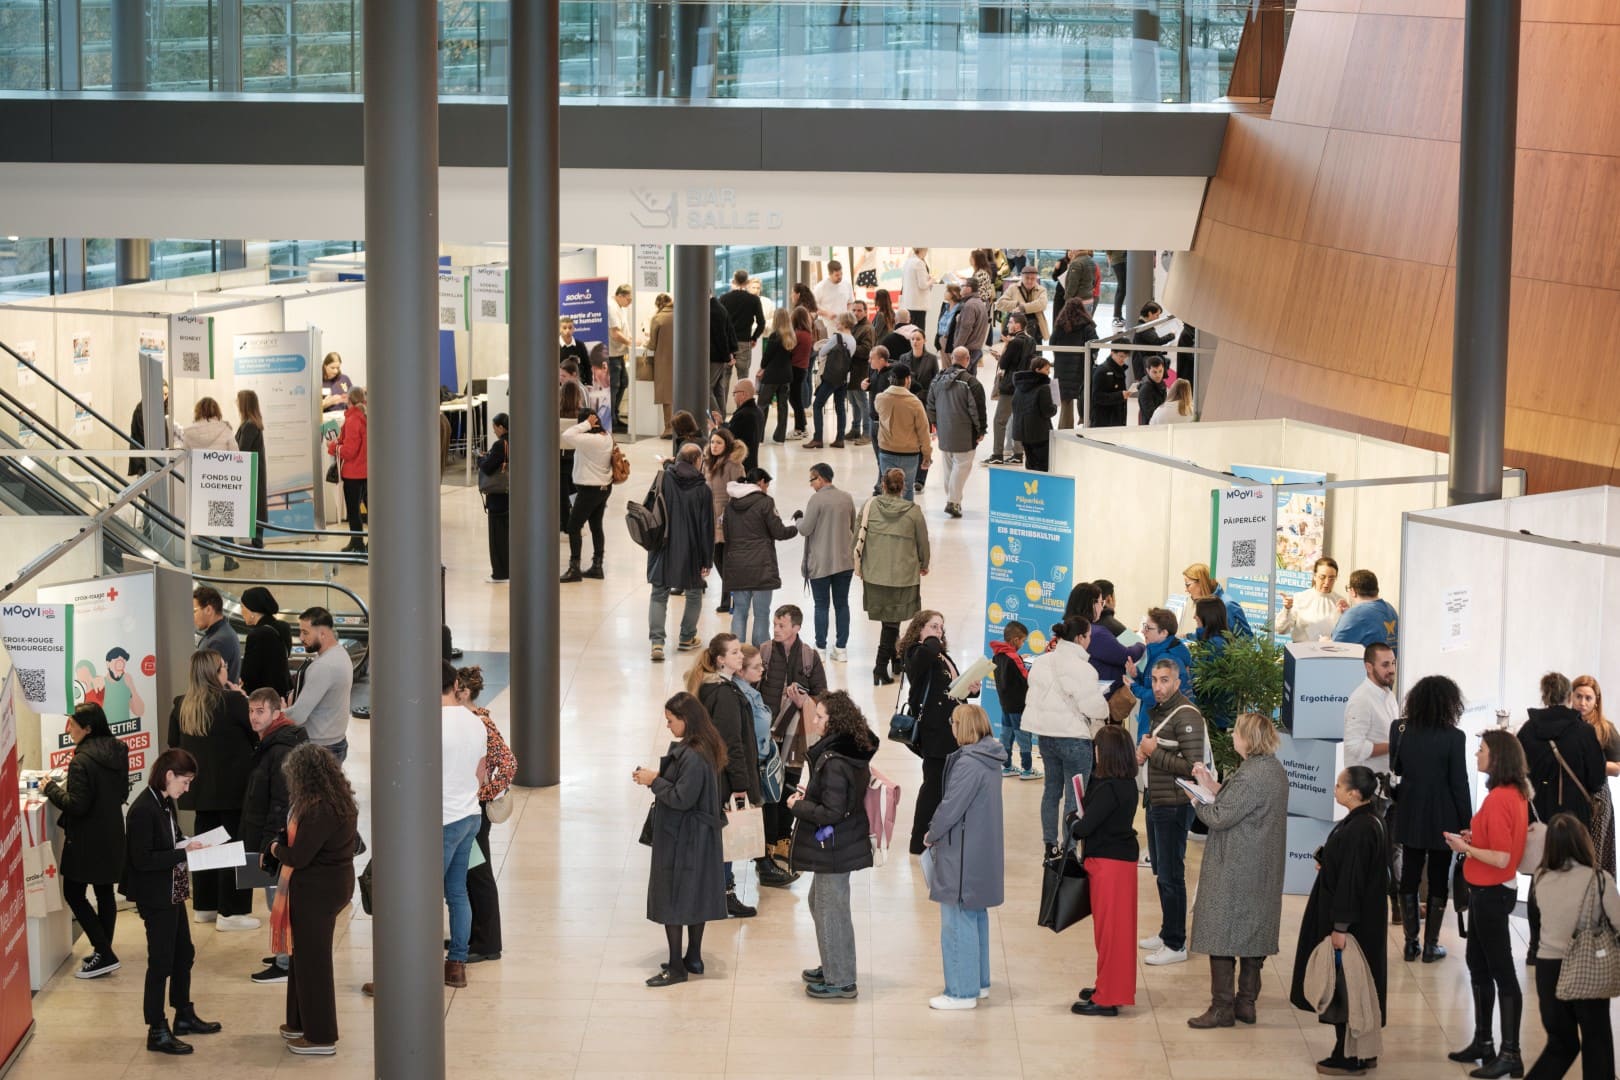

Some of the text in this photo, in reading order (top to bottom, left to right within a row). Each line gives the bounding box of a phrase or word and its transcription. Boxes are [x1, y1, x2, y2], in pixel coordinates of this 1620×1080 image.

[687, 187, 736, 207] BAR
[687, 209, 784, 230] SALLE D
[203, 451, 233, 462] MOOVI
[201, 473, 229, 481] FONDS
[200, 482, 243, 491] LOGEMENT
[1226, 489, 1253, 500] MOOVI
[1223, 515, 1267, 525] PÄIPERLECK
[3, 605, 41, 618] MOOVI
[5, 644, 65, 652] EMBOURGEOISE
[1300, 693, 1349, 703] Ergothérap
[109, 719, 137, 735] ETTRE
[1283, 759, 1315, 771] Infirmier
[1289, 782, 1327, 794] chiatrique
